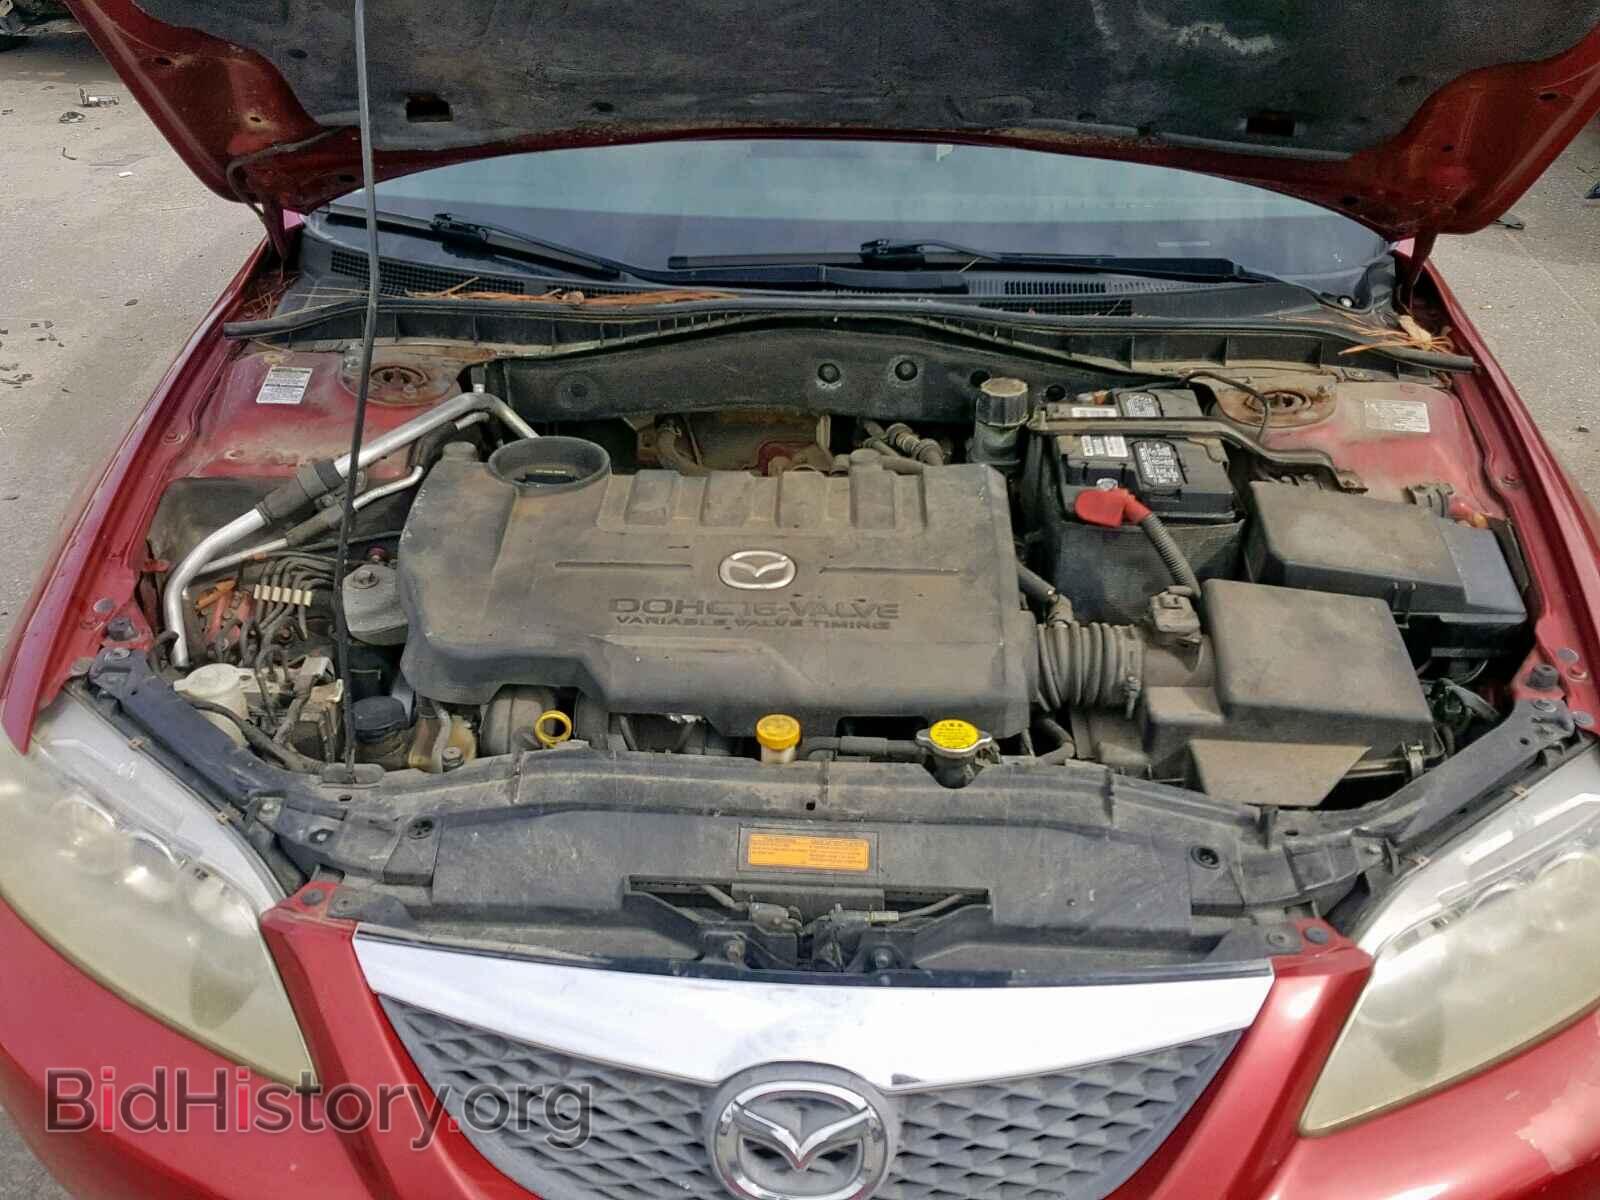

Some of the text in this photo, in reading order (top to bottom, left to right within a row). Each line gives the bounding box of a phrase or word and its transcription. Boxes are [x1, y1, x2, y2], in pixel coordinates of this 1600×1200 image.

[608, 598, 735, 616] DOHC
[616, 615, 891, 630] VARIABLE VALVE TIMING
